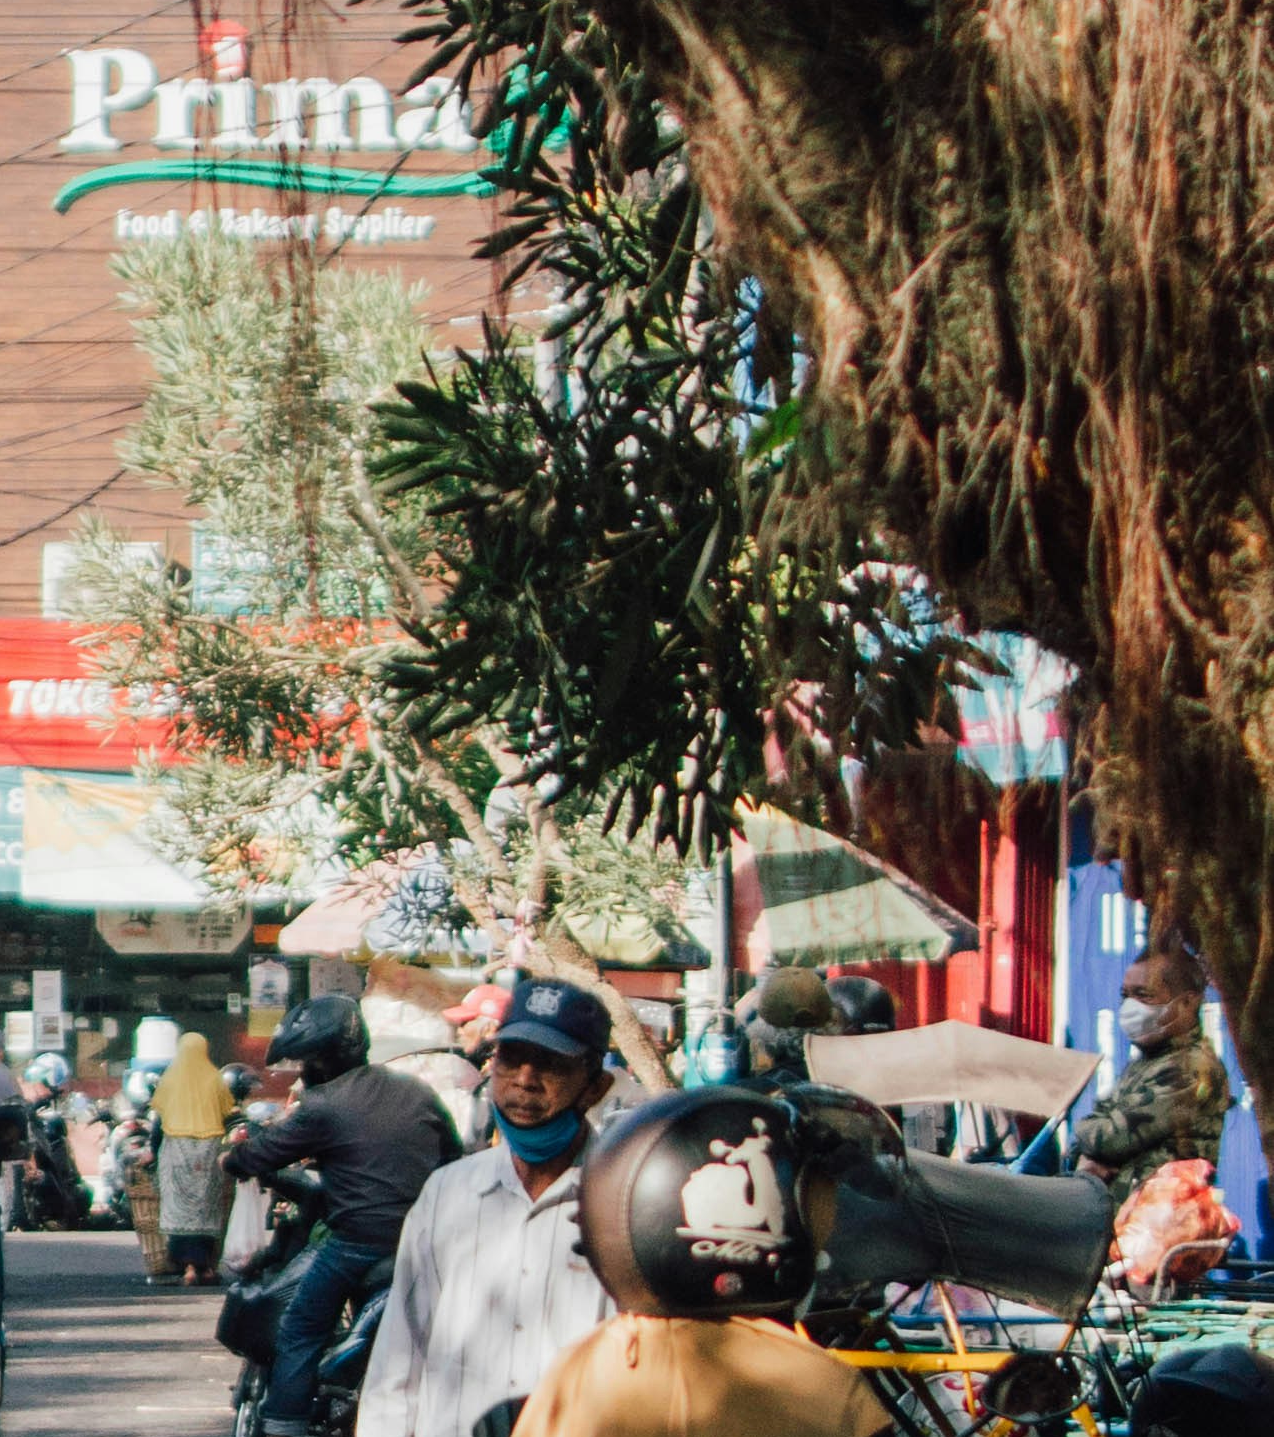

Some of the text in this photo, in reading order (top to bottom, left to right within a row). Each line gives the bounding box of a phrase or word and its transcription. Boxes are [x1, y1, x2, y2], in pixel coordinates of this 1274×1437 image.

[57, 21, 480, 153] Prima
[117, 209, 180, 238] Food
[326, 206, 436, 243] Supplier
